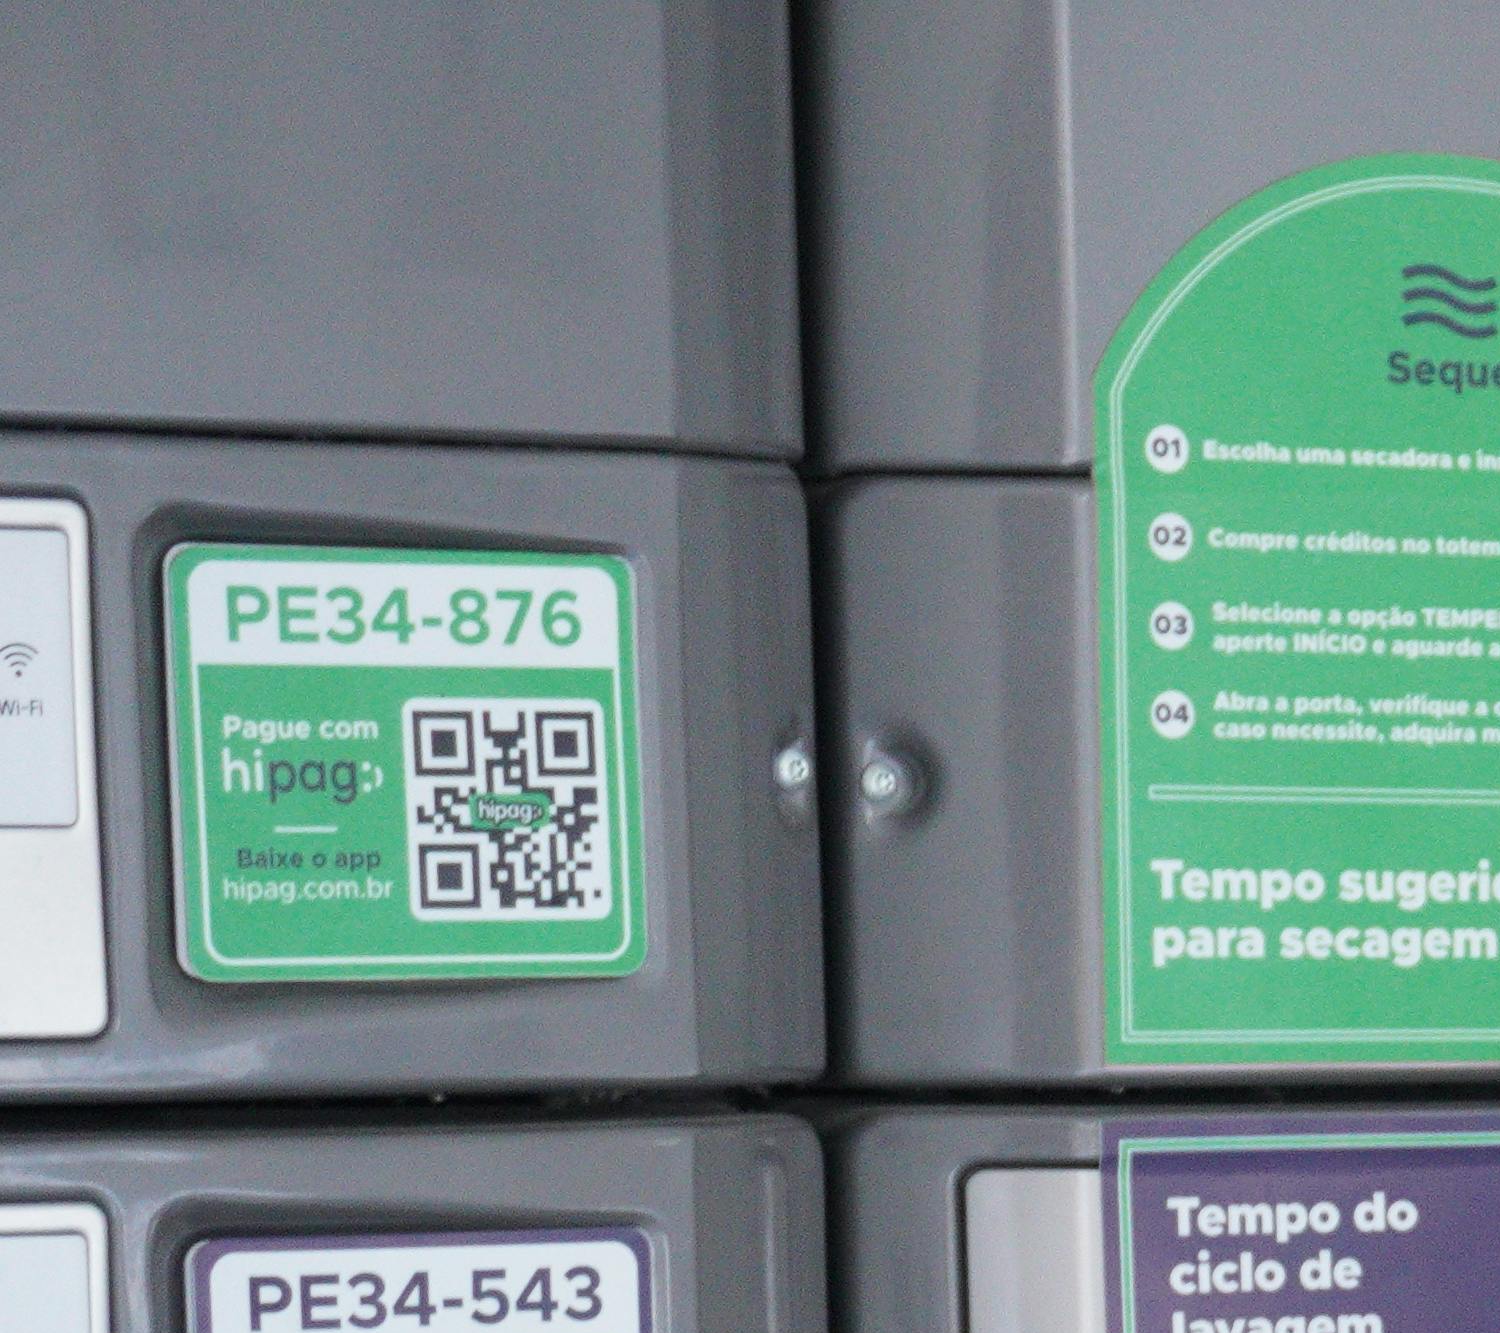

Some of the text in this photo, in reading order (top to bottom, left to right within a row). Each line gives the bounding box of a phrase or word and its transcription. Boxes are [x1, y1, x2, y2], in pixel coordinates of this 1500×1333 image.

[1152, 438, 1180, 458] 01
[1203, 439, 1291, 463] Escolha
[1295, 448, 1346, 465] uma
[1350, 448, 1453, 469] secadora
[1457, 454, 1471, 470] e
[1153, 526, 1186, 546] 02
[1207, 527, 1299, 553] Compre
[1303, 531, 1397, 554] créditos
[1401, 538, 1431, 554] no
[226, 585, 581, 647] PE34-876
[1154, 615, 1187, 635] 03
[1212, 601, 1322, 624] Selecione
[1328, 609, 1342, 625] a
[1347, 607, 1417, 629] opção
[1213, 633, 1288, 654] aperte
[1293, 632, 1367, 654] INÍCIO
[1372, 639, 1386, 655] e
[1391, 637, 1483, 660] aguarde
[1155, 703, 1189, 723] 04
[1213, 690, 1270, 712] Abra
[1274, 696, 1289, 713] a
[1369, 694, 1470, 719] verifique
[1474, 701, 1489, 716] a
[222, 715, 379, 744] Pague com
[1213, 722, 1267, 739] caso
[1390, 721, 1477, 746] adquira
[237, 847, 382, 873] Baixe o app
[223, 876, 393, 904] hipag.com.br
[1150, 859, 1325, 910] Tempo
[1152, 926, 1498, 967] para secagem
[1167, 1191, 1418, 1241] Tempo do
[1169, 1249, 1362, 1295] ciclo de
[249, 1265, 602, 1332] PE34-543
